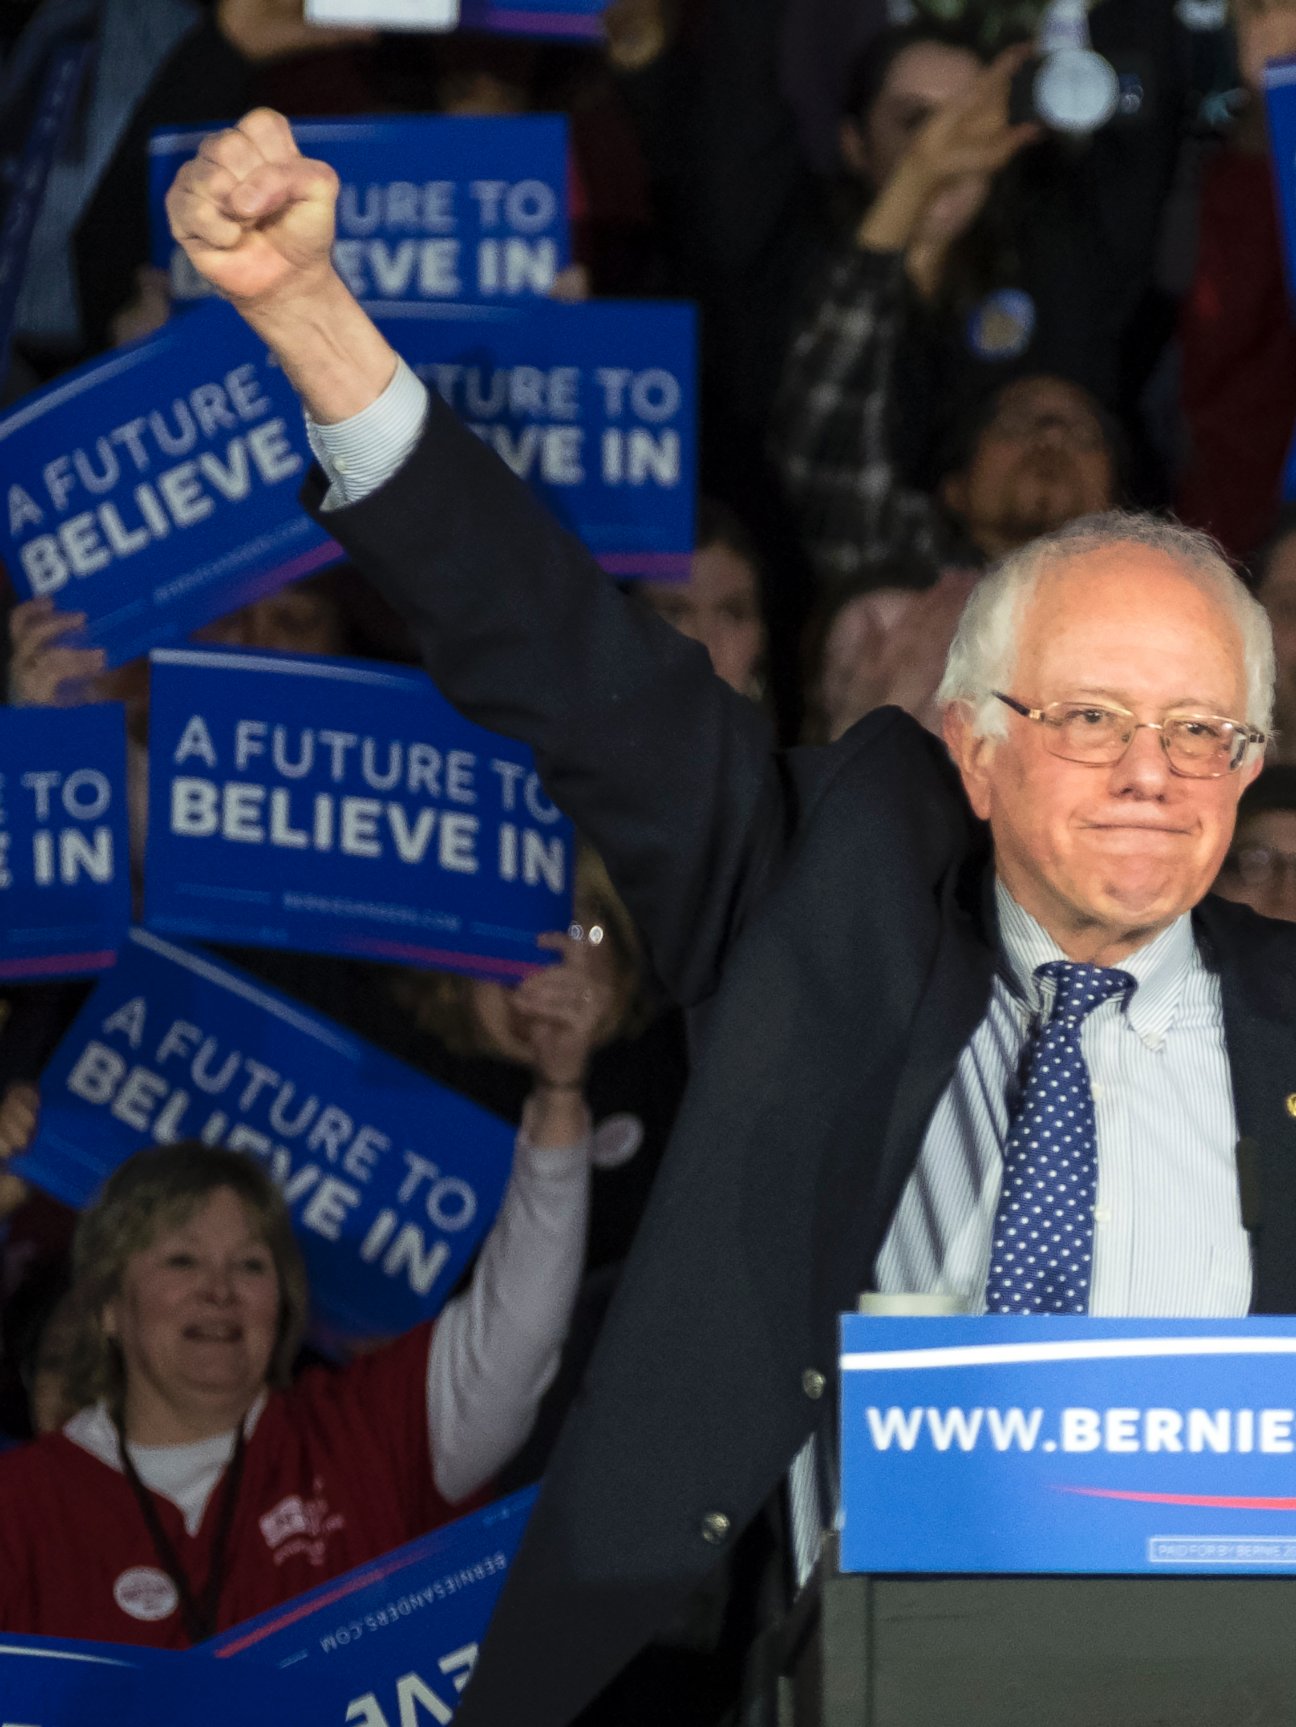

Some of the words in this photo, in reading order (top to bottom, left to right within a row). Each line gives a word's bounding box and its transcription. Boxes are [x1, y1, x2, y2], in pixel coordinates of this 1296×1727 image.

[339, 179, 457, 235] URE
[468, 179, 556, 232] TO
[478, 237, 557, 297] IN
[413, 363, 581, 421] TURE
[596, 366, 682, 423] TO
[7, 482, 44, 537] A
[43, 362, 272, 513] FUTURE
[601, 425, 682, 489] IN
[20, 416, 303, 596] BELIEVE
[21, 768, 112, 821] TO
[174, 714, 217, 768] A
[234, 719, 478, 804] FUTURE
[33, 827, 114, 887] IN
[170, 775, 480, 875] BELIEVE
[499, 822, 566, 896] IN
[103, 996, 147, 1048] A
[156, 1018, 392, 1185] FUTURE
[398, 1150, 478, 1233] TO
[360, 1207, 451, 1296] IN
[320, 1551, 507, 1654] BERNIESANDERS.COM
